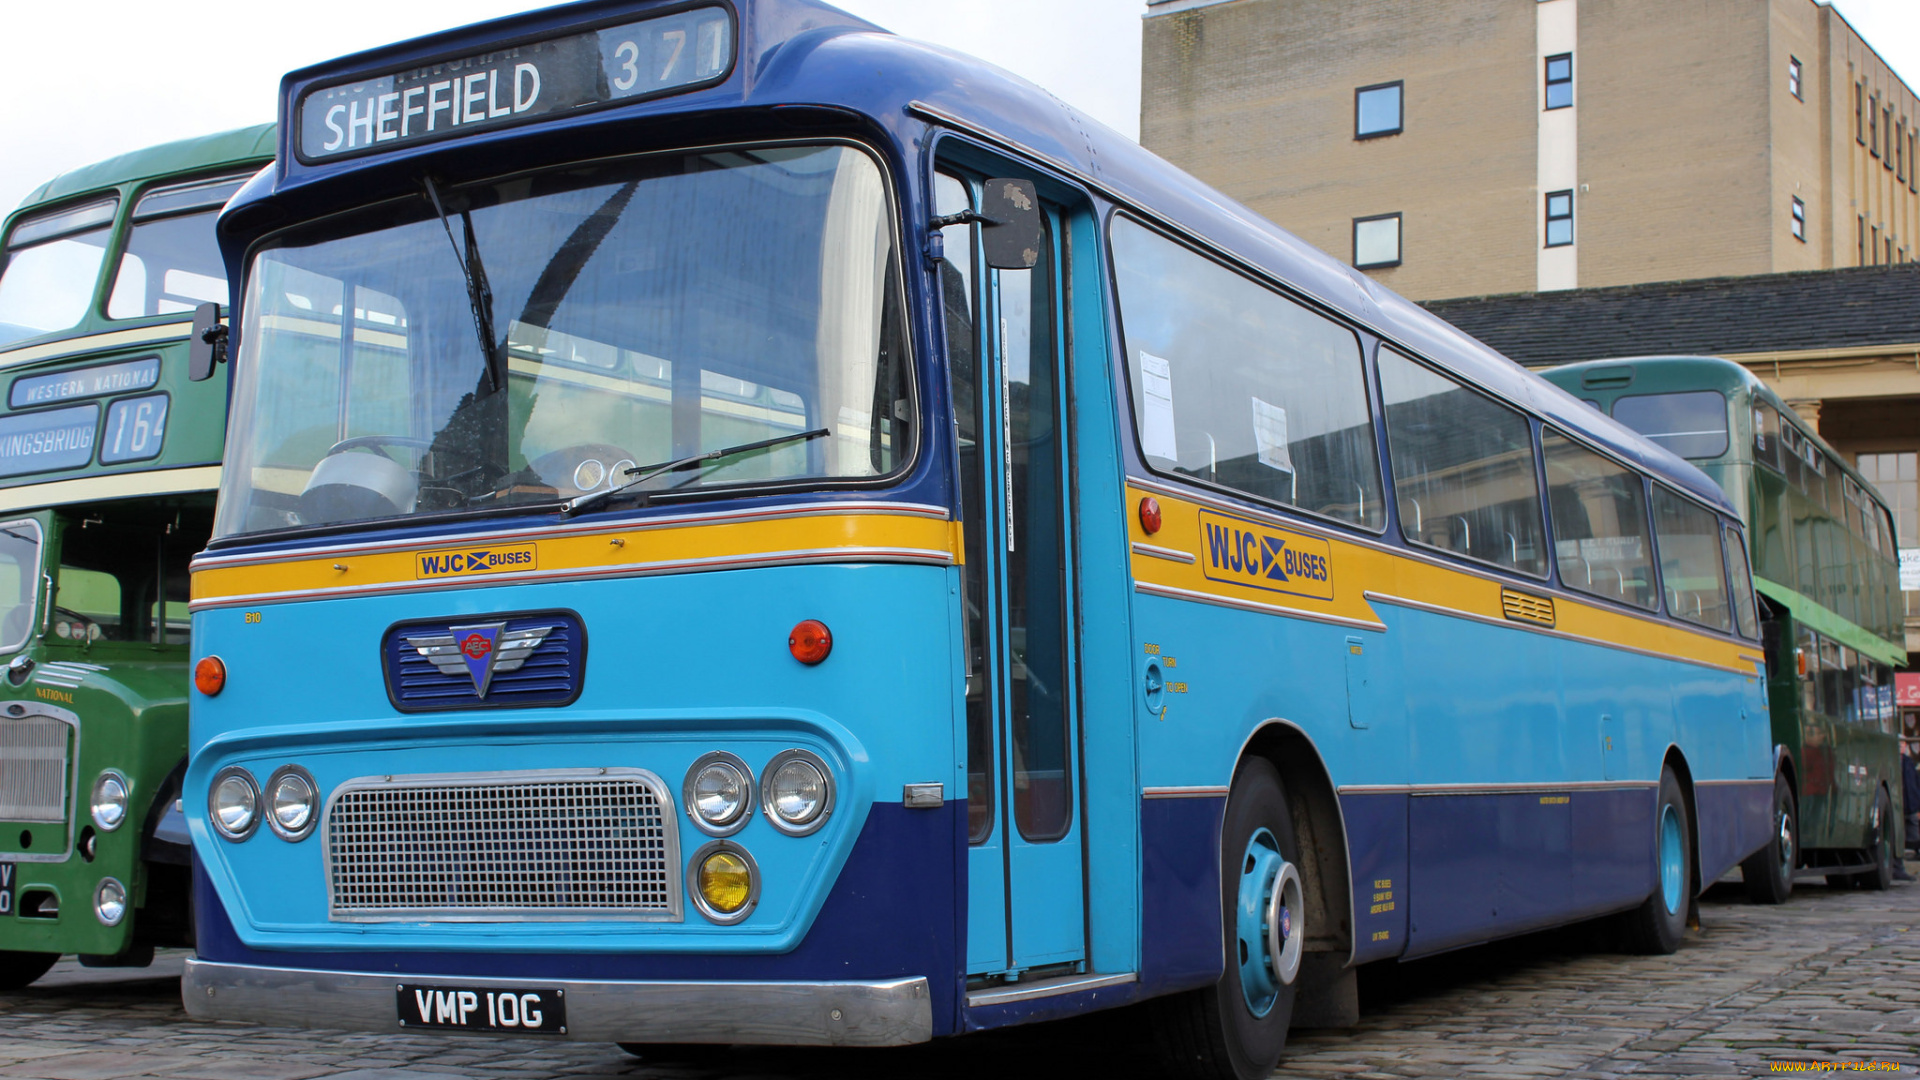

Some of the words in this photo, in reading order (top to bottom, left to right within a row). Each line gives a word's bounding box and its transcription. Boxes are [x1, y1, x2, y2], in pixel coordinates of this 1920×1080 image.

[323, 62, 541, 151] SHEFFIELD
[27, 379, 85, 402] WESTERN
[94, 367, 156, 392] NATIONAL
[0, 424, 96, 458] KINGSBRIDG
[422, 554, 464, 574] WJC
[489, 551, 531, 566] BUSES
[1206, 523, 1259, 576] WJC
[1284, 548, 1327, 582] BUSES
[245, 612, 262, 624] B10
[35, 687, 74, 704] NATIONAL
[415, 989, 478, 1025] VMP
[487, 993, 543, 1028] 10G
